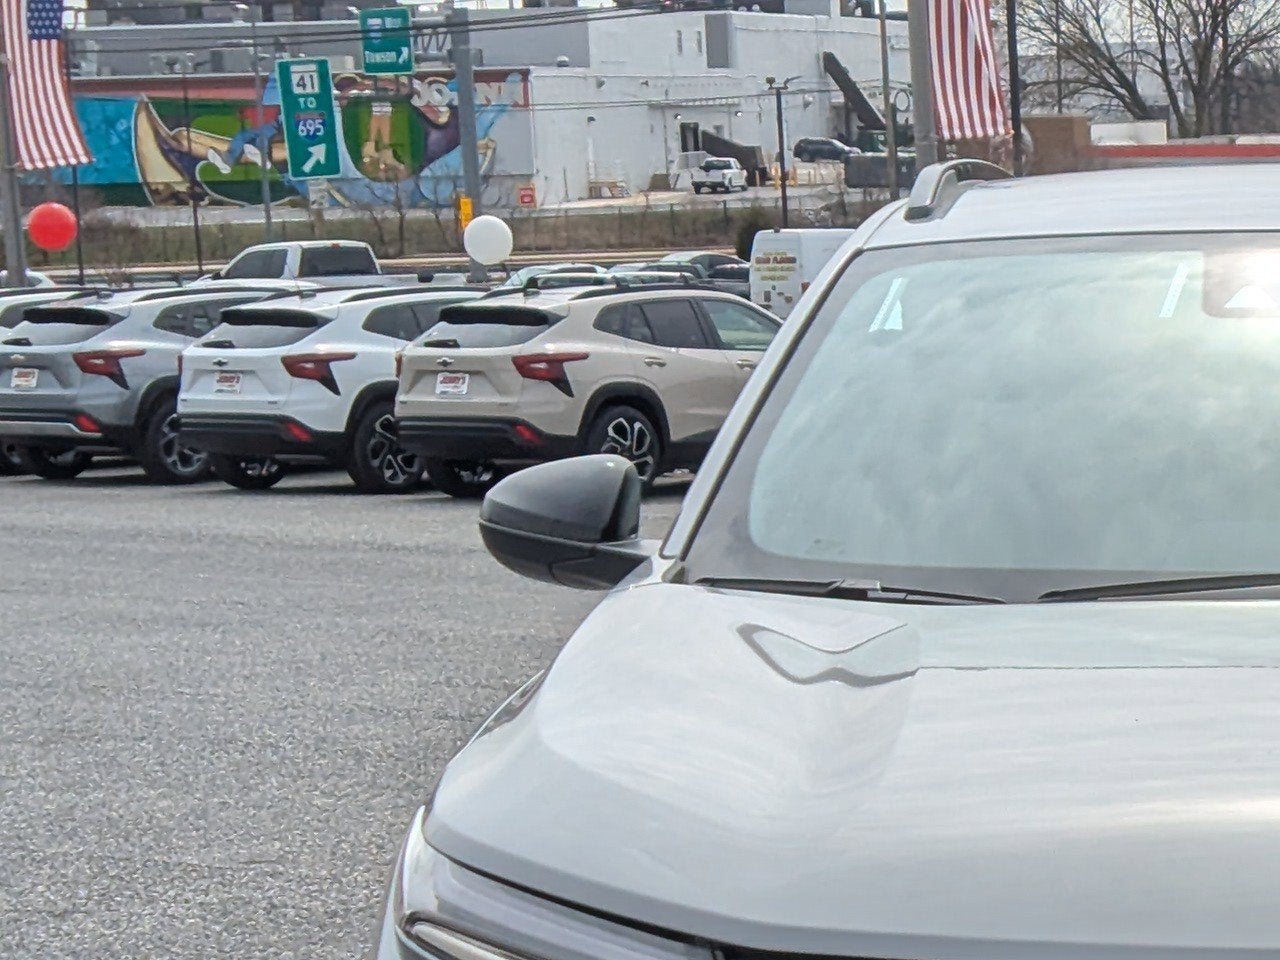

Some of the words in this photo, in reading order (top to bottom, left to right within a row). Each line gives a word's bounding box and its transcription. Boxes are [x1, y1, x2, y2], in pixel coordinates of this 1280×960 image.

[296, 79, 316, 95] 41
[298, 97, 317, 109] TO
[298, 120, 324, 136] 695
